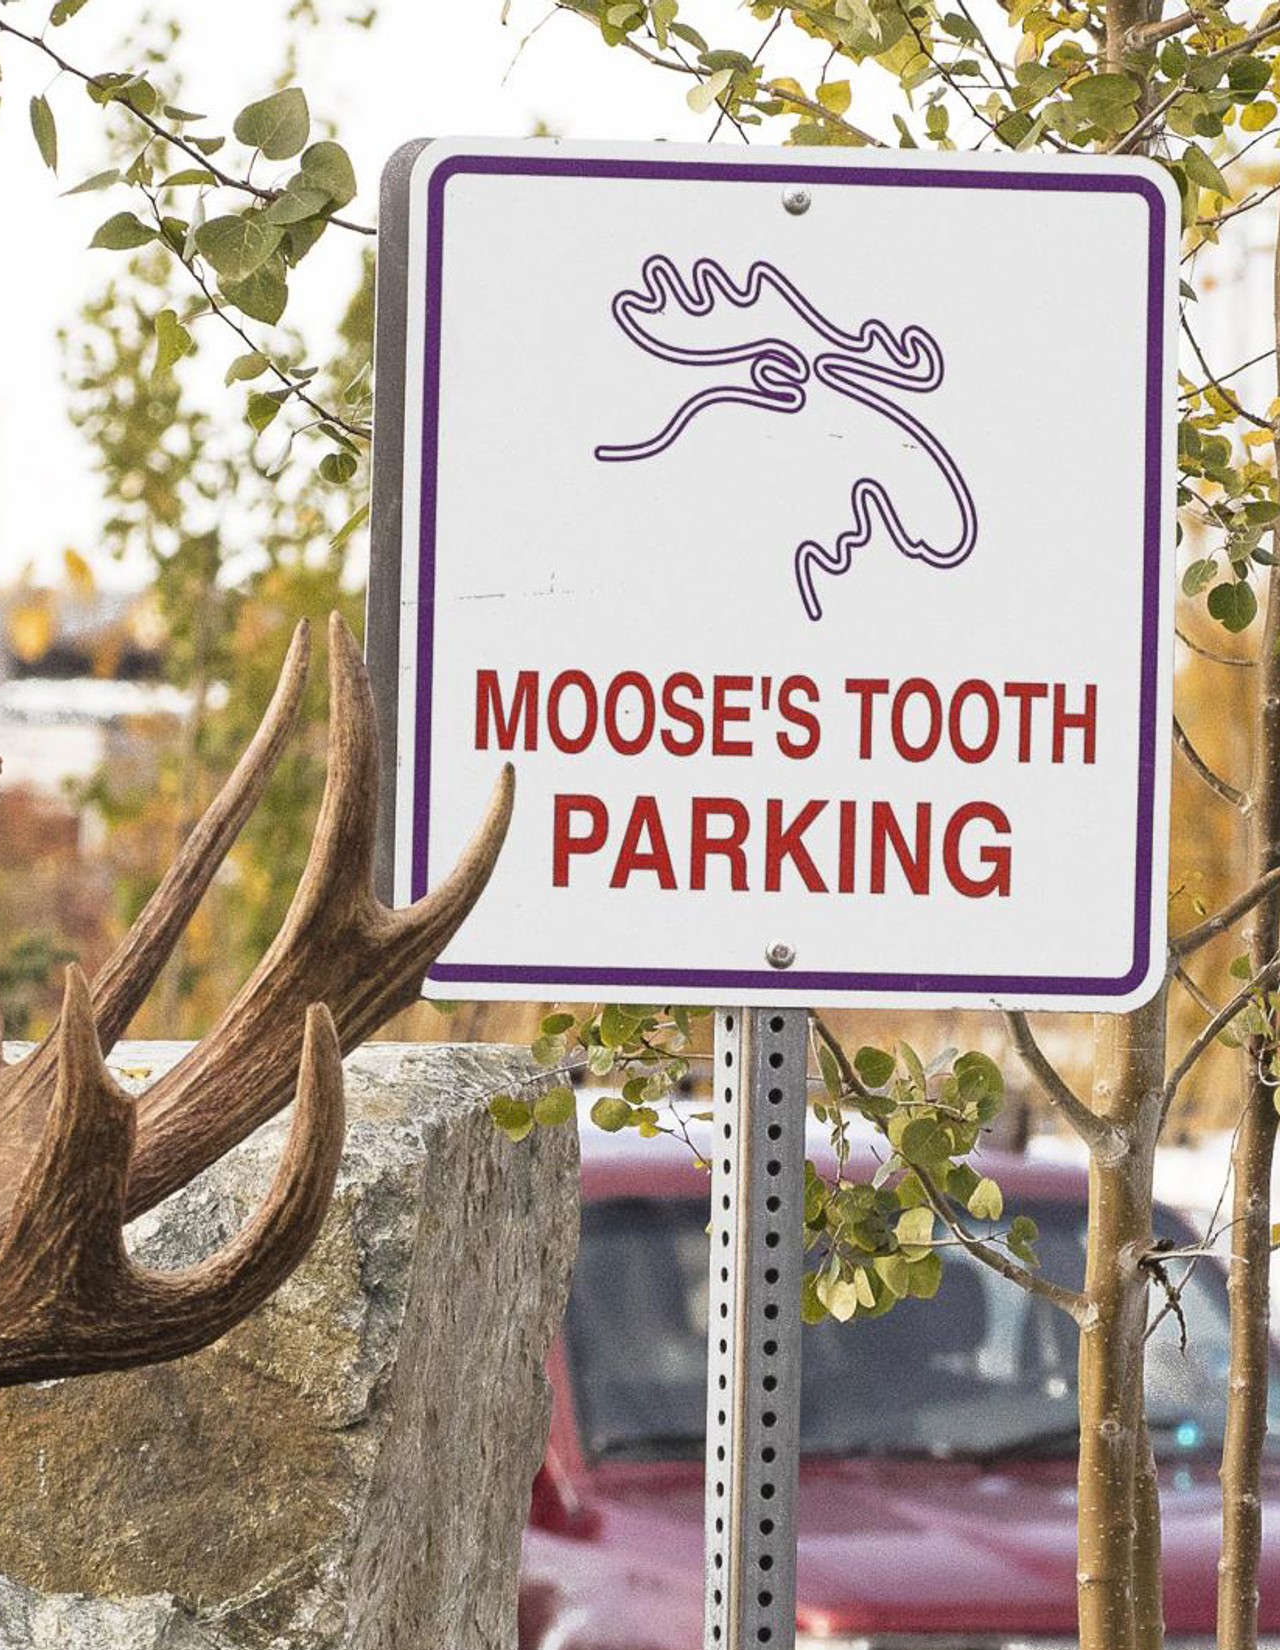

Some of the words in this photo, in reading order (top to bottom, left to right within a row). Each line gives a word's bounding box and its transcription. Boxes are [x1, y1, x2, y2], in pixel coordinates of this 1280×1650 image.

[475, 669, 821, 760] MOOSE'S
[844, 677, 1097, 765] TOOTH
[552, 794, 1013, 898] PARKING
